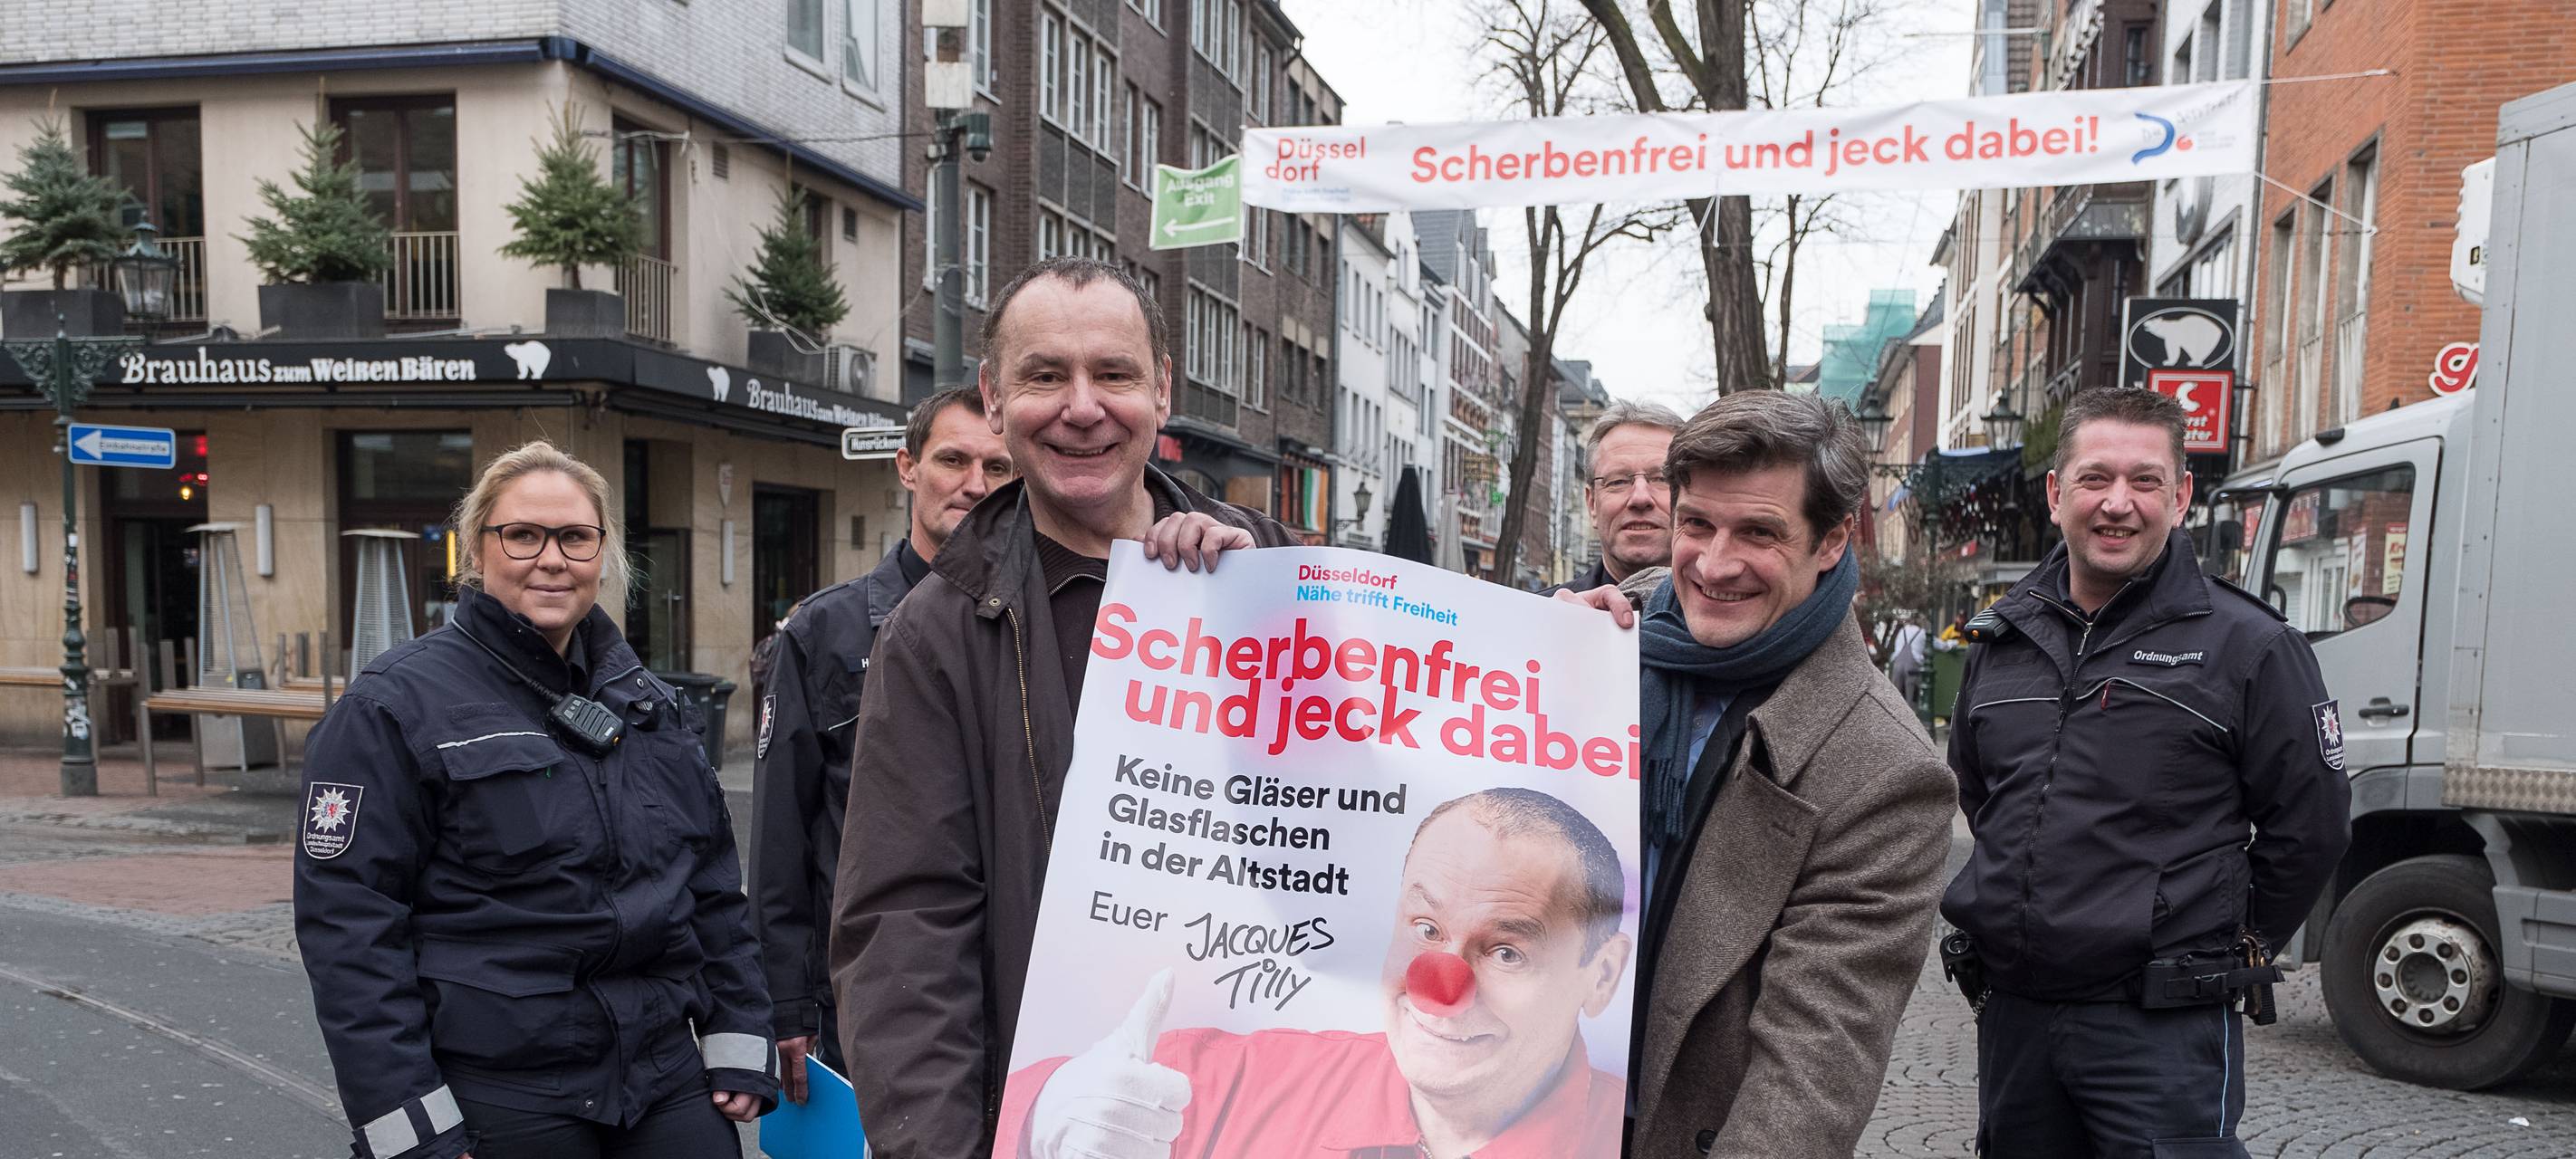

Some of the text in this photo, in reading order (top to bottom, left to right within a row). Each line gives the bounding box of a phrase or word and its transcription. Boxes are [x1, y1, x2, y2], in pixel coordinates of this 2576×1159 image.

[1278, 136, 1367, 160] Düssel
[1411, 115, 2099, 183] Scherbenfrei und jeck dabei!
[1165, 174, 1235, 194] Ausgang
[1265, 159, 1321, 182] dorf
[1184, 191, 1215, 206] Exit
[120, 345, 272, 384] Brauhaus
[273, 366, 312, 382] zum
[400, 356, 477, 380] Bären
[746, 378, 819, 420] Brauhaus
[1298, 564, 1398, 590] Düsseldorf
[1296, 585, 1458, 627] Nähe trifft Freiheit
[1091, 602, 1541, 714] Scherbenfrei
[2133, 649, 2204, 666] Ordnungsamt
[1125, 676, 1640, 780] und jeck dabei
[1114, 754, 1407, 814] Keine Gläser und
[1108, 793, 1331, 850] Glasflaschen
[1099, 831, 1350, 896] in der Altstadt
[1090, 891, 1336, 962] Euer JACQUES
